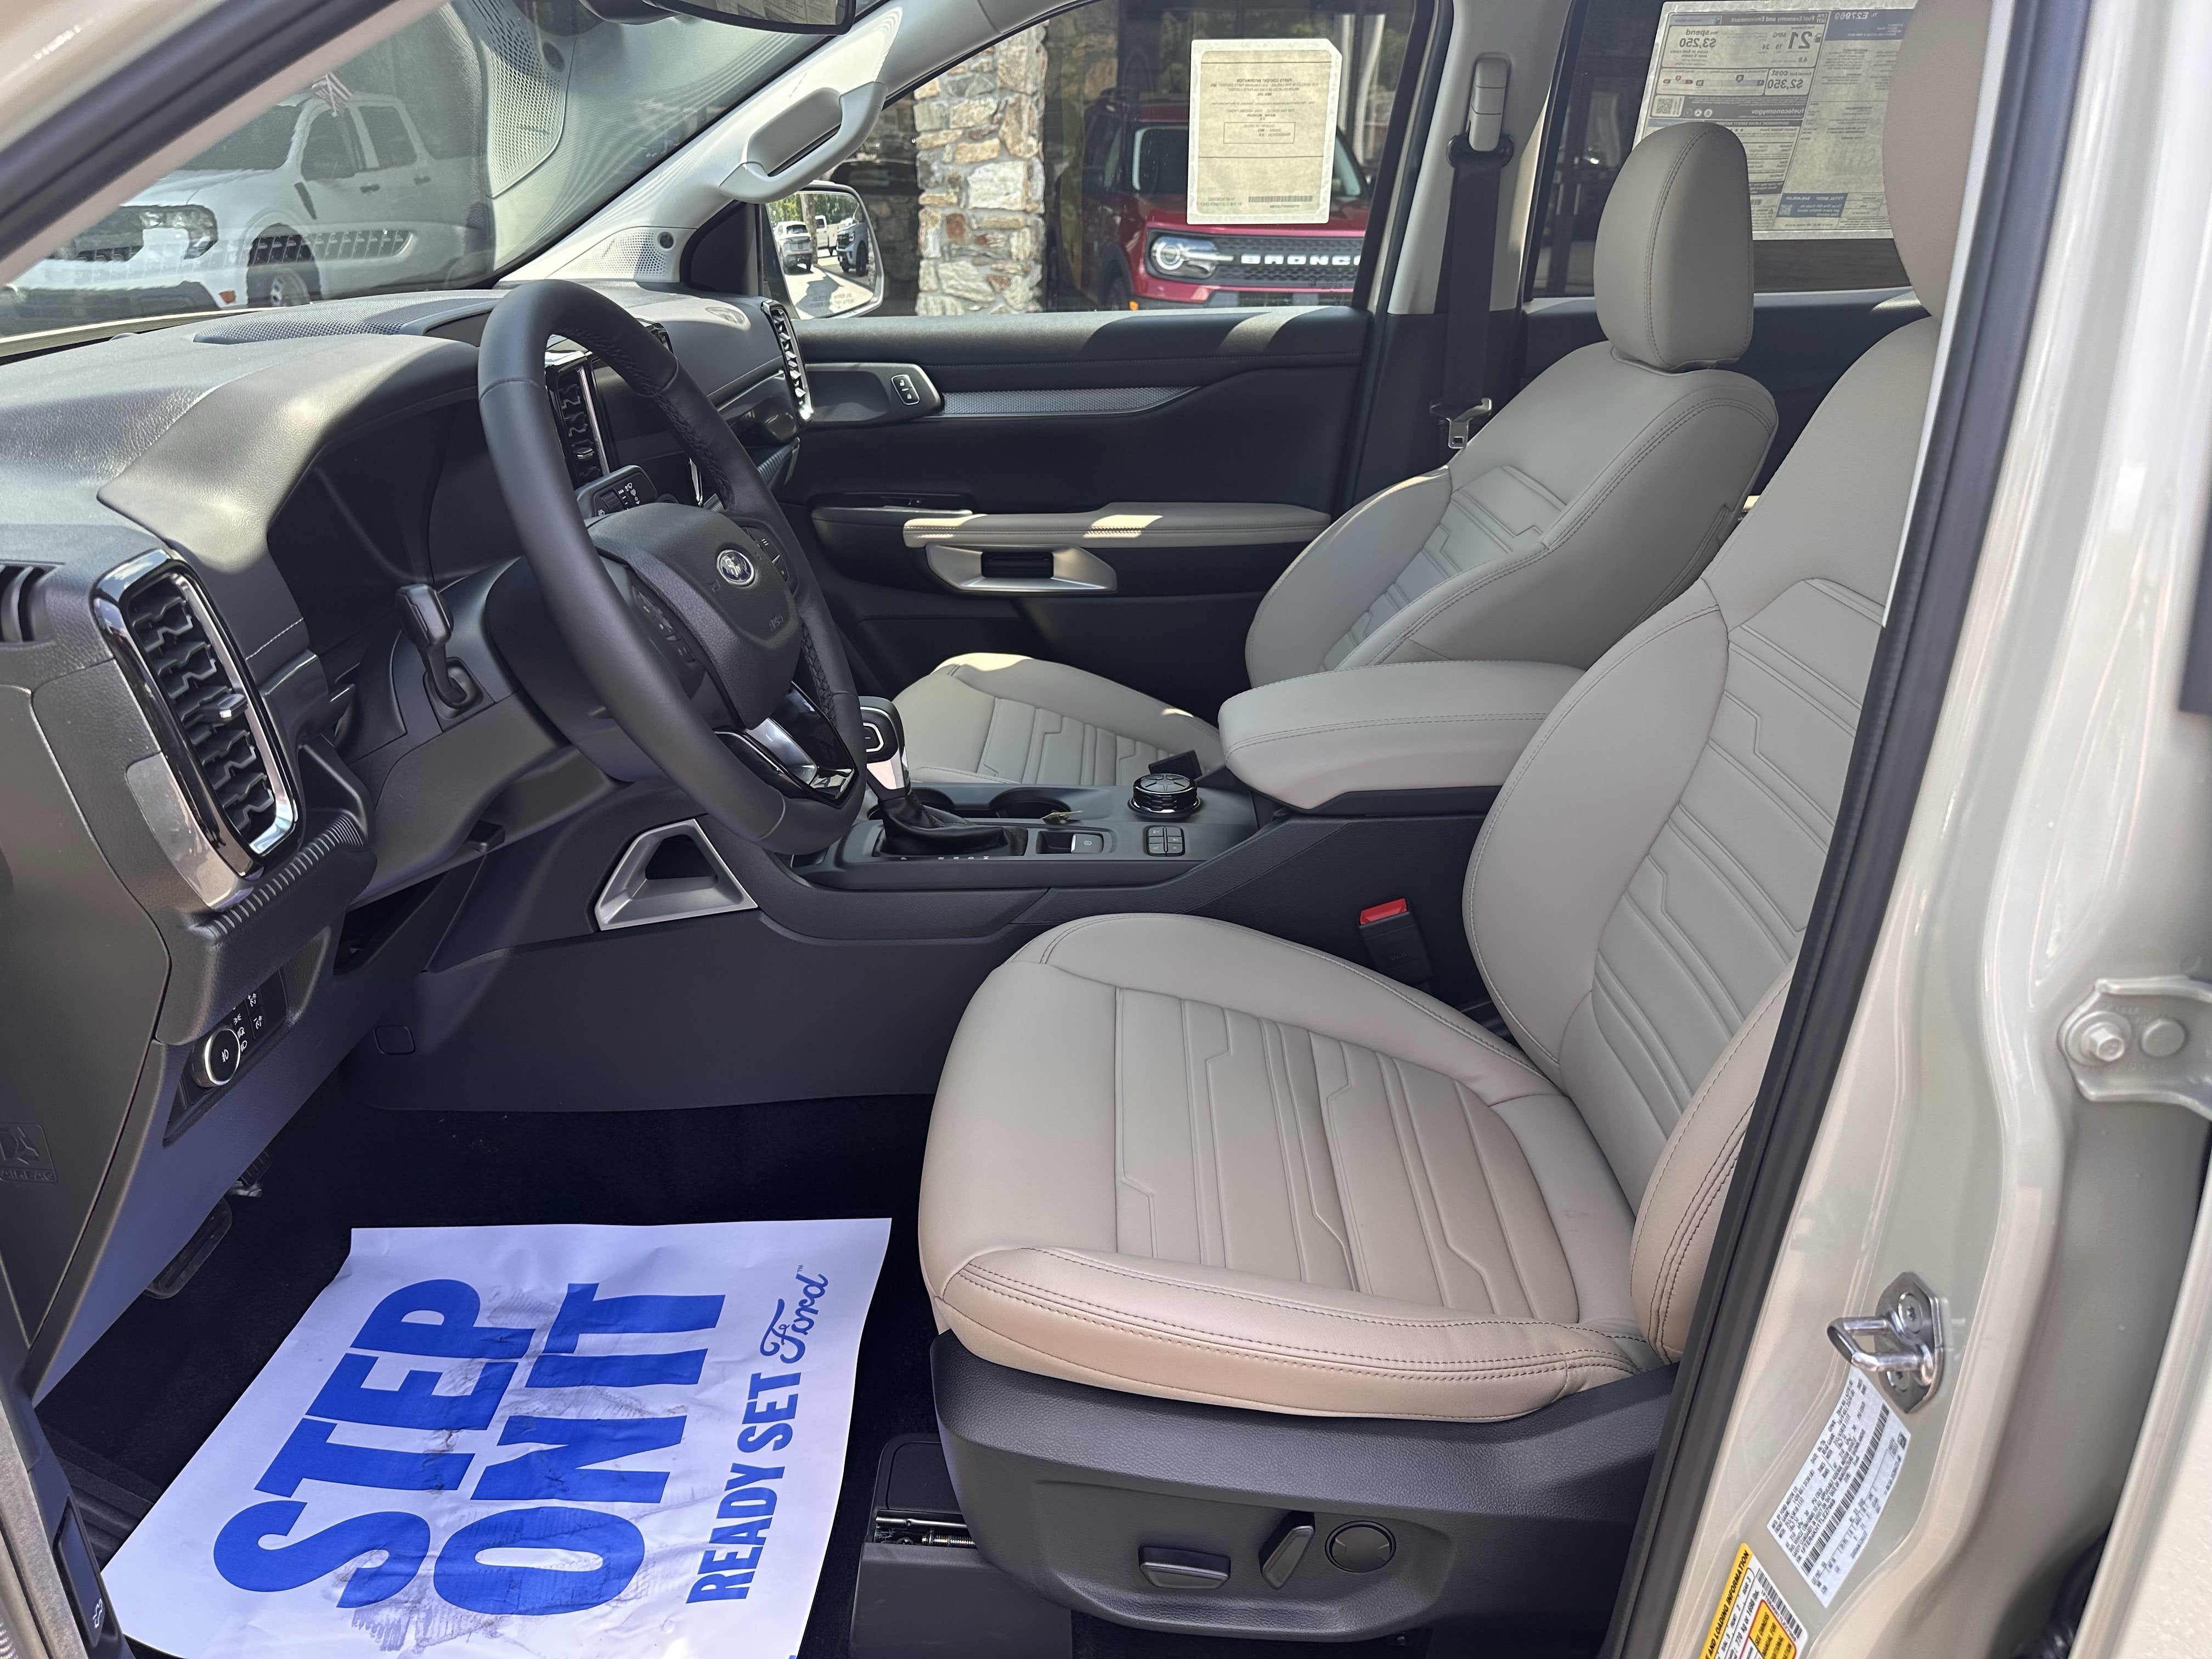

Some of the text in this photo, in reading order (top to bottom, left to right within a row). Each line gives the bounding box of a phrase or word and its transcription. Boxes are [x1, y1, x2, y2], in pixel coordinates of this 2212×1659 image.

[1241, 255, 1361, 266] BRONC
[213, 1278, 536, 1609] STEP
[433, 1283, 726, 1616] ON IT
[687, 1273, 828, 1604] READY SET Ford
[1793, 1528, 1803, 1547] VEHICLE
[1802, 1511, 1815, 1532] CONFORMS
[1820, 1479, 1834, 1501] APPLICABLE
[1841, 1451, 1849, 1466] MOTOR
[1799, 1522, 1813, 1548] STANDARDS
[1814, 1506, 1823, 1522] EFFECT
[1707, 1550, 1749, 1658] AND LOADING INFORMATION
[1740, 1623, 1747, 1633] kg
[1747, 1600, 1755, 1615] 1698
[1759, 1612, 1770, 1636] OWNERS
[1762, 1634, 1773, 1657] MANUAL
